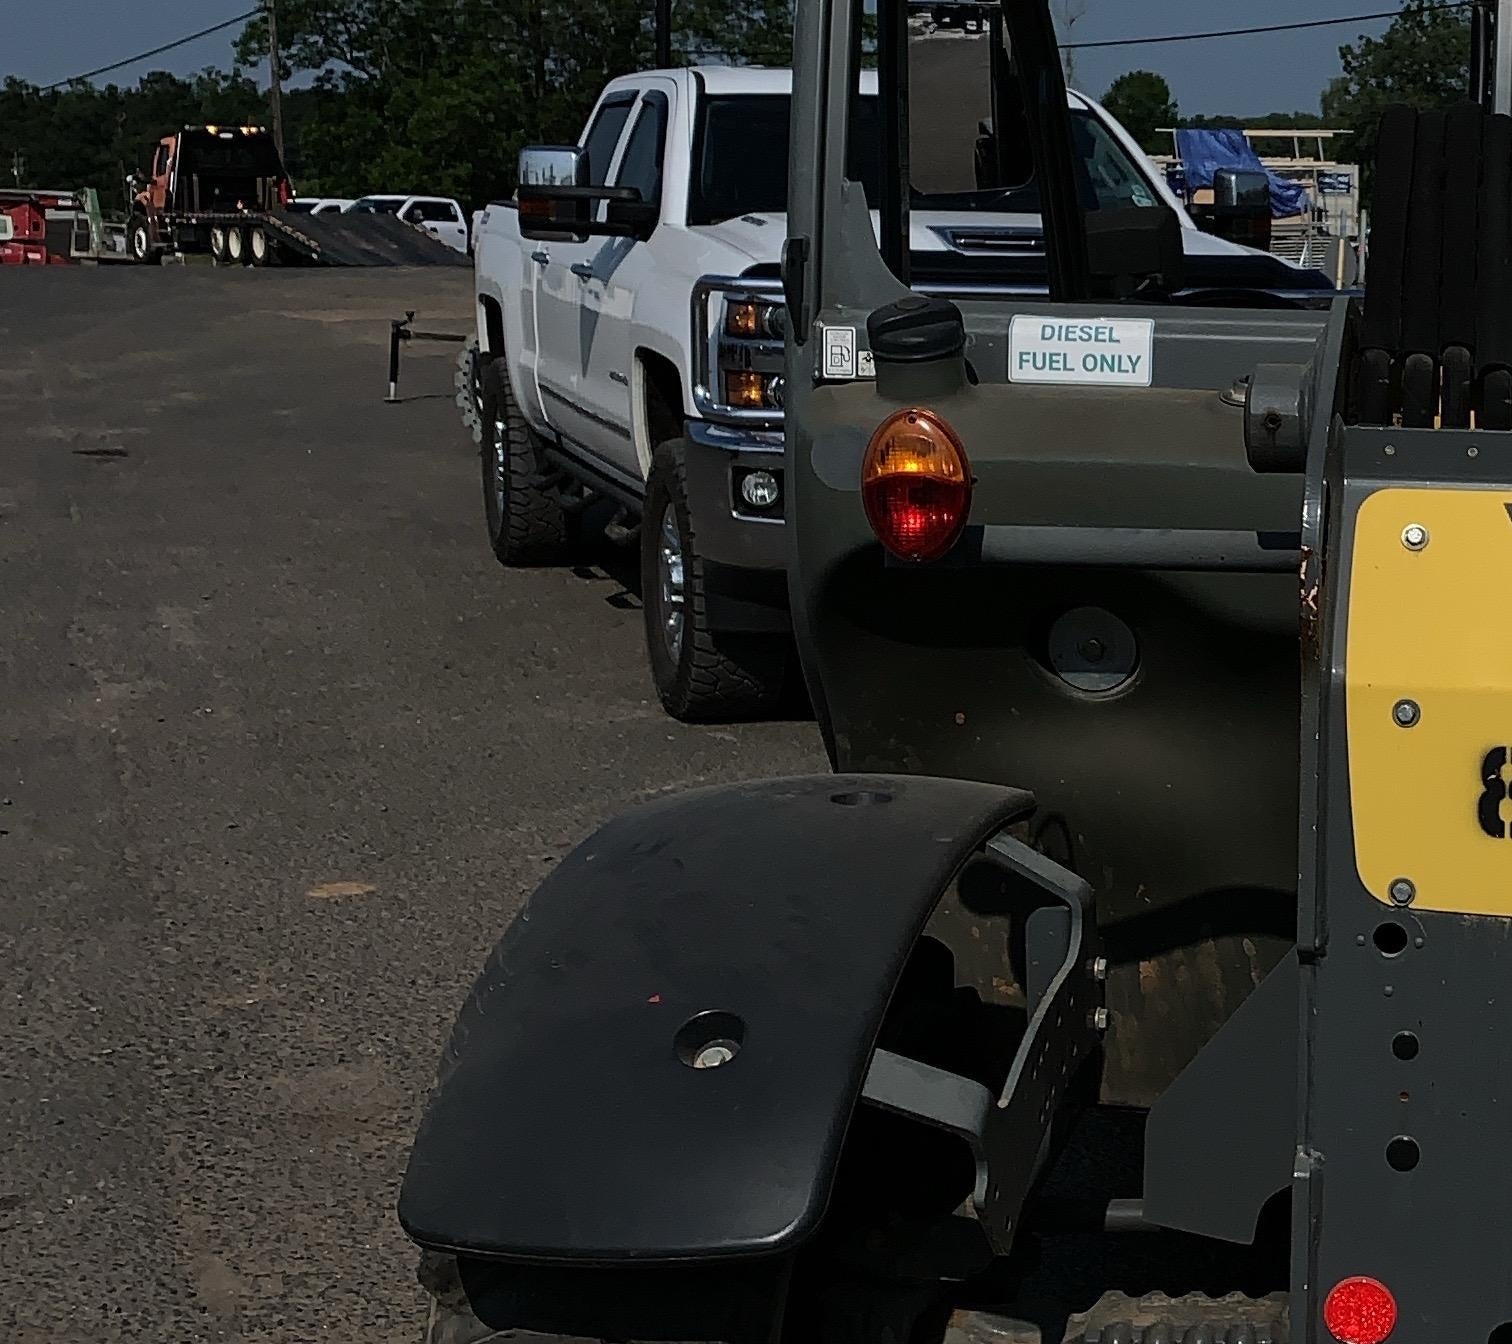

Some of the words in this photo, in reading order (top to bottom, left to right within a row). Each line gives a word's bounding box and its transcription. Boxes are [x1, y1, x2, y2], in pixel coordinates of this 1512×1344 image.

[1040, 324, 1121, 344] DIESEL
[1018, 351, 1075, 372] FUEL
[1082, 353, 1143, 375] ONLY
